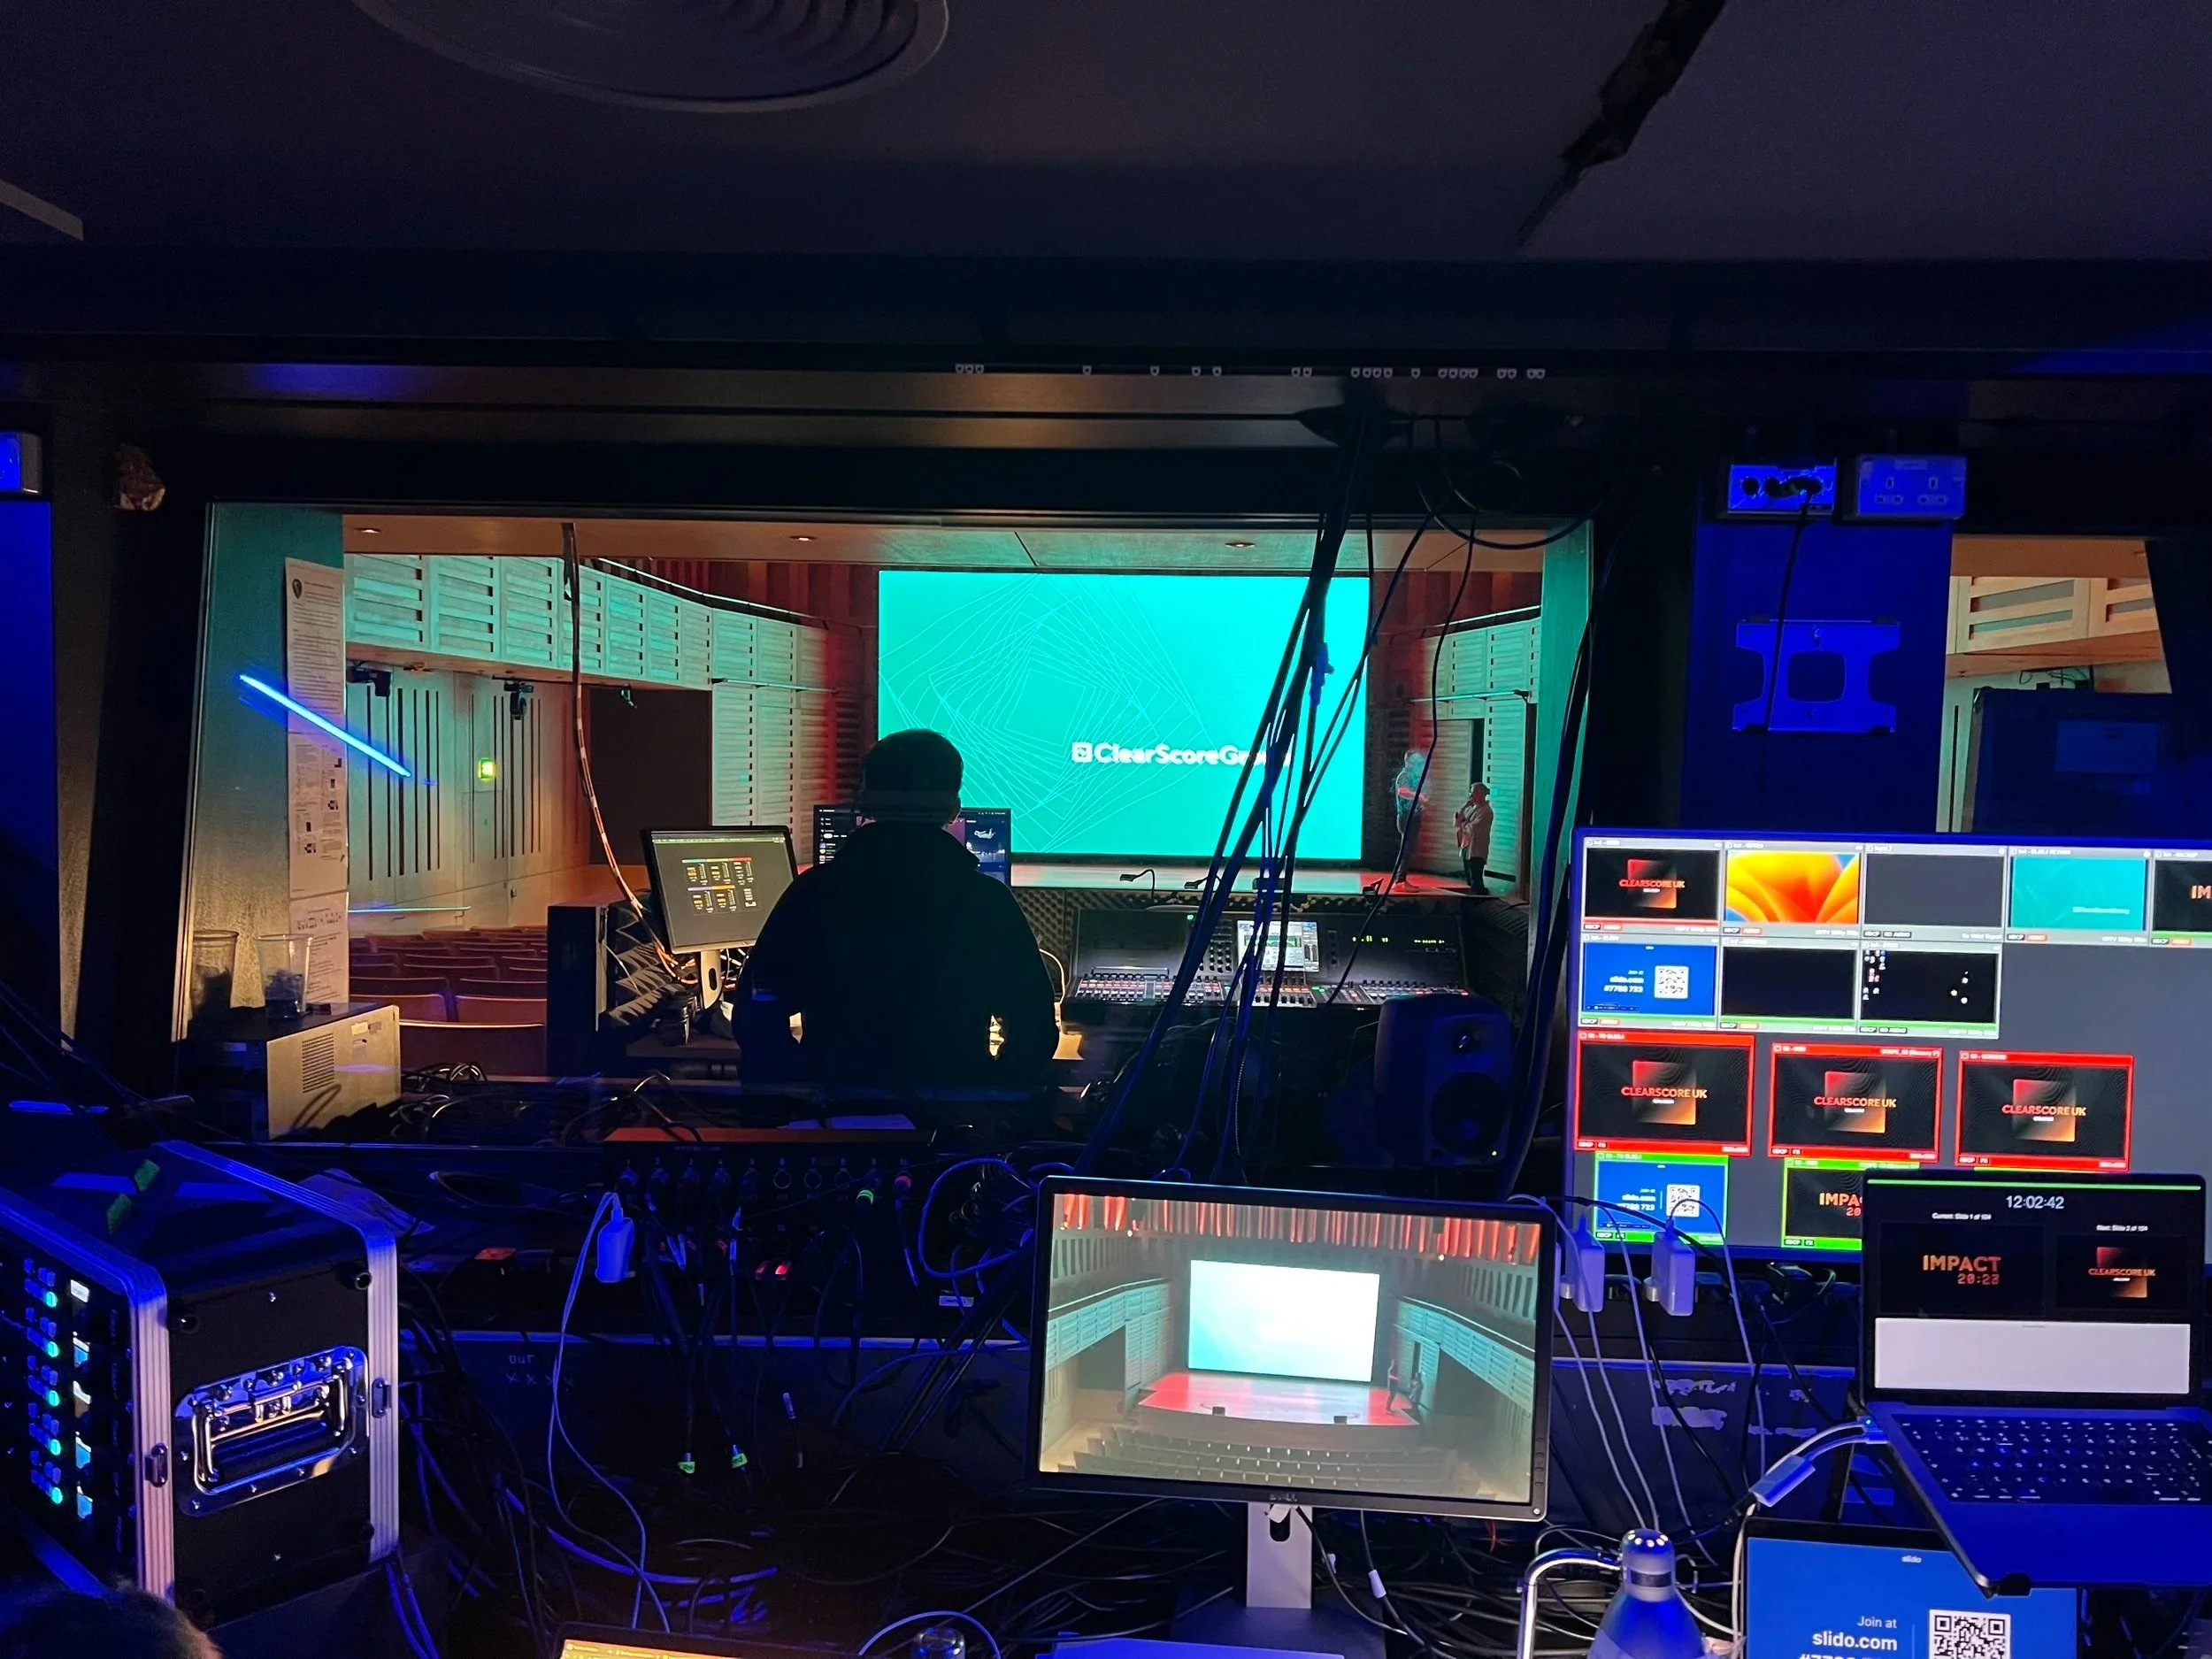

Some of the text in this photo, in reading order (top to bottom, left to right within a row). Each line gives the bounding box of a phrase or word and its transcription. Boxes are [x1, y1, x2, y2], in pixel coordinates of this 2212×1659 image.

[1094, 742, 1292, 768] ClearScoreGr
[1621, 1087, 1708, 1099] CLEARSCORE UK
[1814, 1096, 1897, 1108] CLEARSCORE UK
[2001, 1104, 2086, 1117] CLEARSCORE UK
[1819, 1193, 1863, 1206] IMPA
[2006, 1195, 2065, 1210] 12:02:42
[1923, 1255, 2001, 1272] IMPACT
[1957, 1273, 2000, 1285] 20:23
[1901, 1555, 1922, 1563] slido
[1857, 1617, 1897, 1629] Join at
[1812, 1631, 1897, 1651] slido.com
